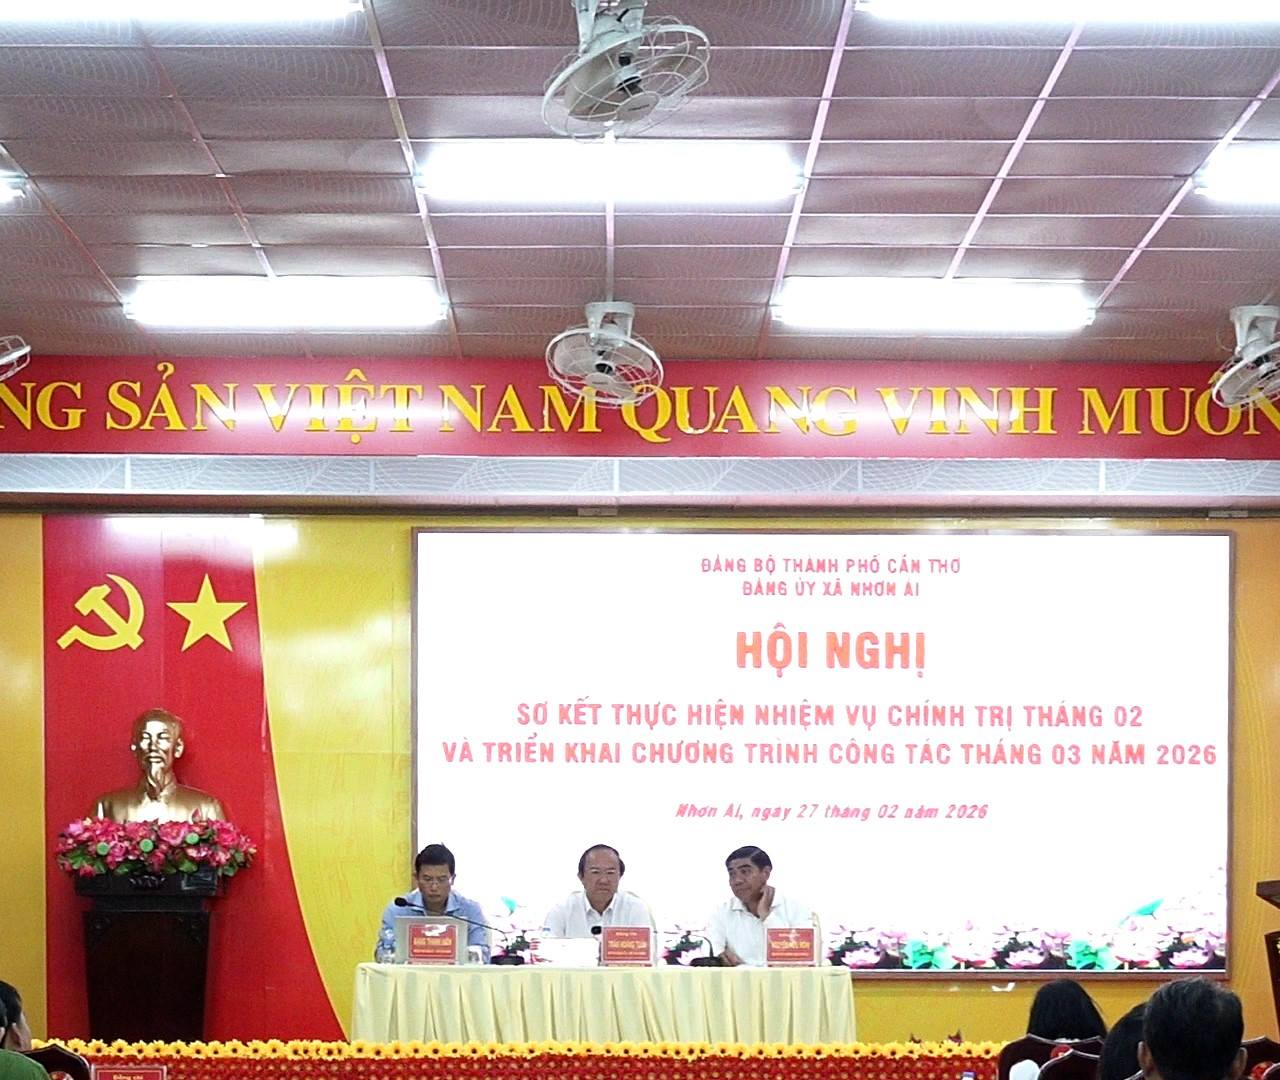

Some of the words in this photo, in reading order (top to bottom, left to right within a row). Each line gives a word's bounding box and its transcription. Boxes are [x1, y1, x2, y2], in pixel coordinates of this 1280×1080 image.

[105, 361, 239, 431] SẢN
[253, 369, 423, 445] VIỆT
[438, 383, 603, 433] NAM
[620, 383, 857, 443] QUANG
[875, 386, 1056, 435] VINH
[928, 557, 961, 573] THƠ
[851, 580, 896, 596] NHƠN
[736, 622, 808, 678] HỘI
[826, 631, 926, 678] NGHỊ
[517, 700, 548, 726] SƠ
[559, 696, 602, 726] KẾT
[611, 702, 677, 730] THỰC
[688, 698, 744, 730] HIỆN
[755, 699, 835, 730] NHIỆM
[846, 705, 877, 731] VỤ
[888, 699, 965, 727] CHÍNH
[975, 705, 1012, 731] TRỊ
[1023, 701, 1103, 728] THÁNG
[1114, 705, 1143, 728] 02
[442, 737, 474, 763] VÀ
[483, 732, 555, 763] TRIỂN
[565, 742, 621, 764] KHAI
[632, 739, 735, 764] CHƯƠNG
[745, 738, 818, 764] TRÌNH
[829, 738, 896, 765] CÔNG
[905, 738, 951, 765] TÁC
[960, 738, 1042, 766] THÁNG
[1052, 743, 1082, 765] 03
[1091, 740, 1146, 766] NĂM
[1157, 744, 1217, 766] 2026
[797, 804, 819, 818] 27
[877, 804, 898, 818] 02
[945, 804, 989, 819] 2026
